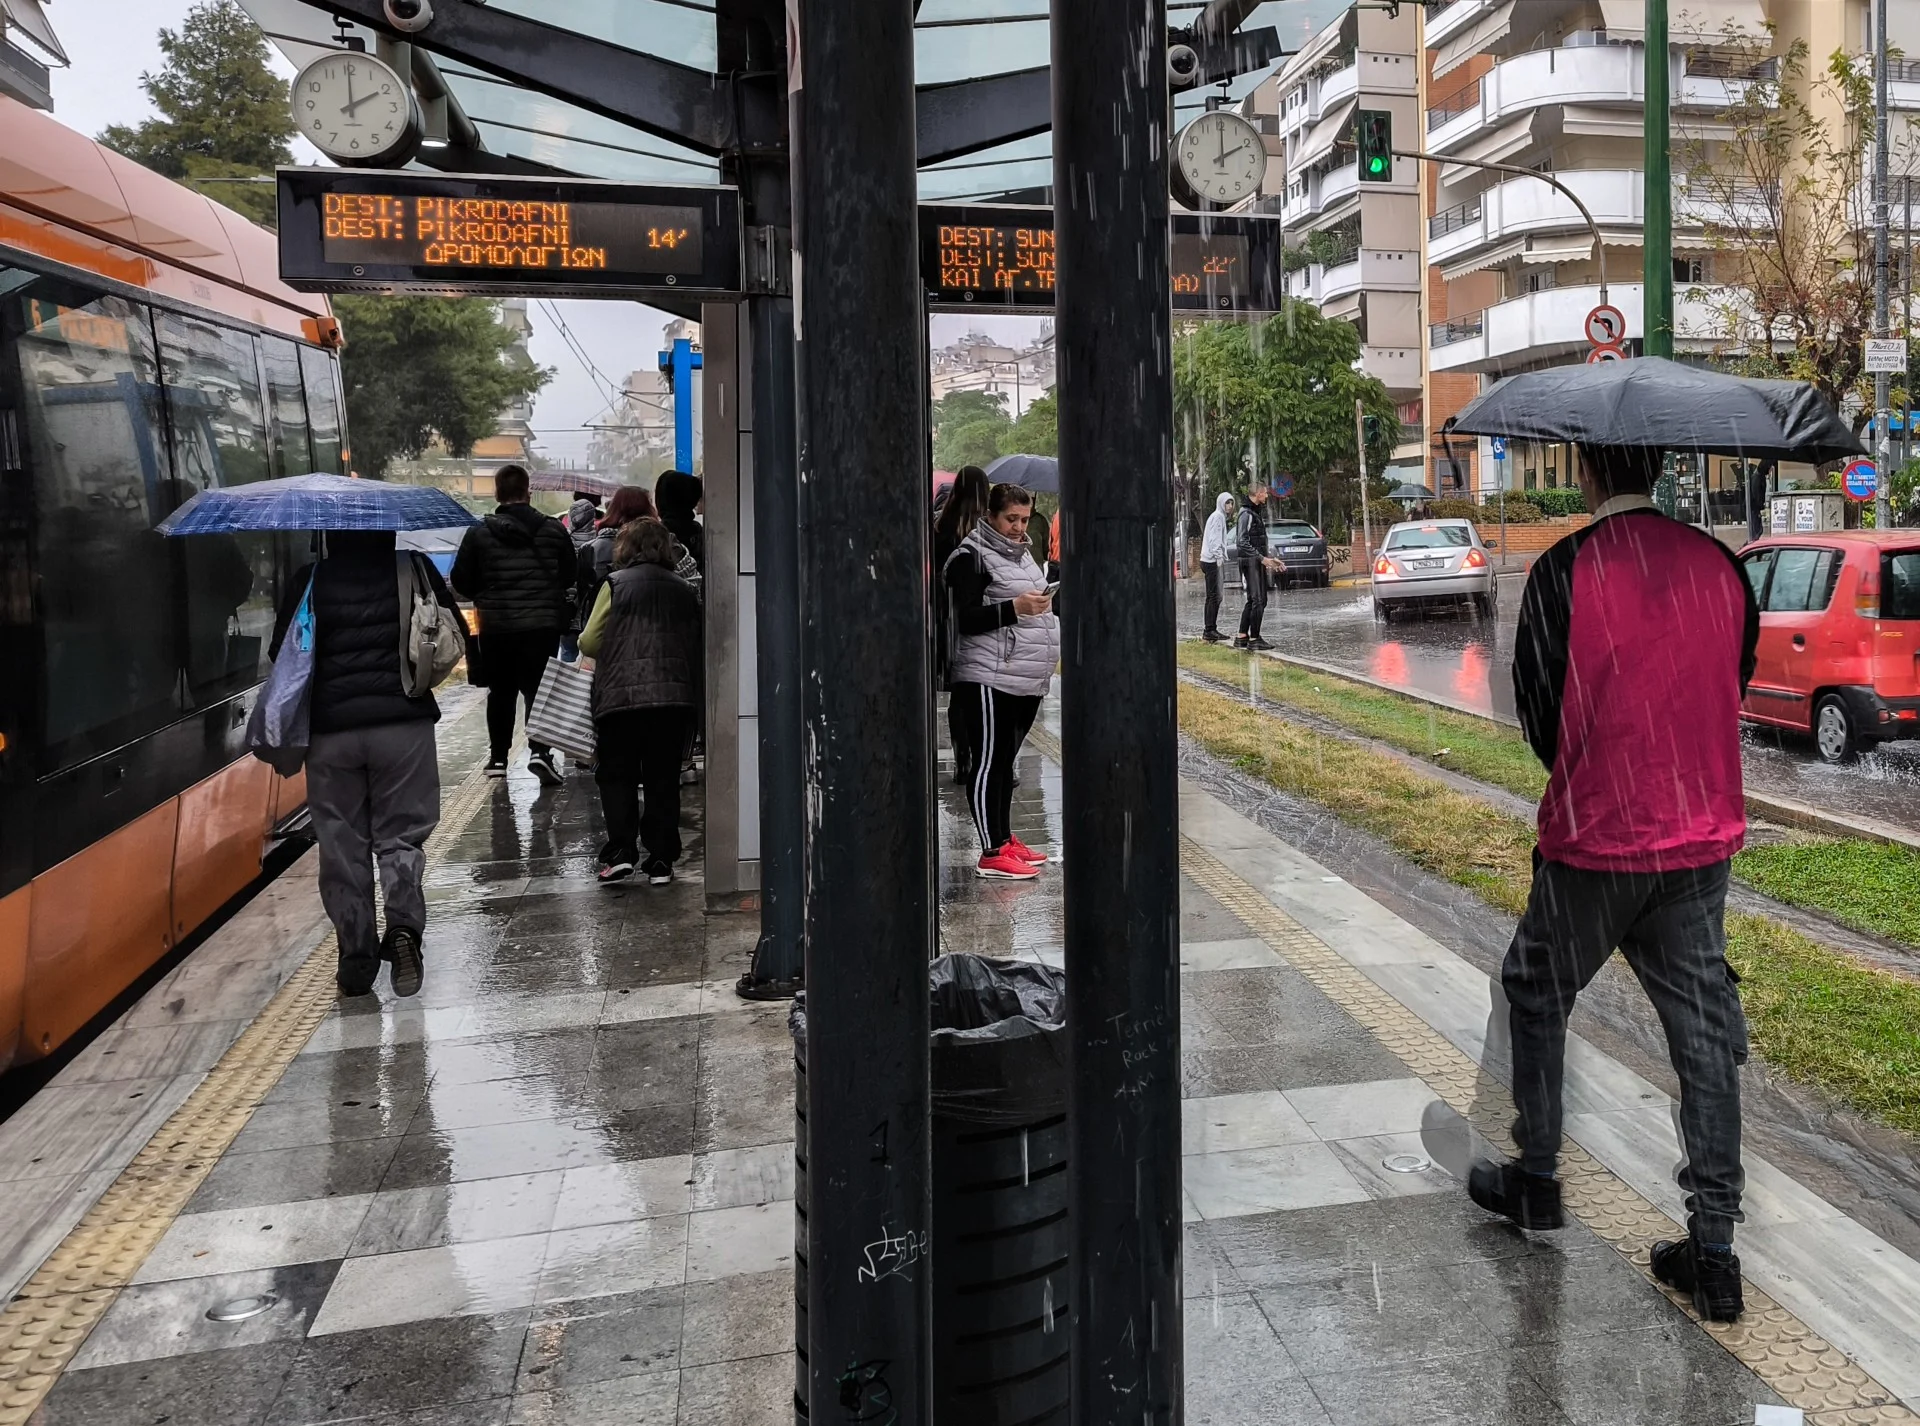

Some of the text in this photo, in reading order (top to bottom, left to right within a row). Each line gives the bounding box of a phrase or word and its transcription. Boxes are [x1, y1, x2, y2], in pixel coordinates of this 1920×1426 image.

[325, 69, 335, 79] 11
[309, 82, 321, 93] 10
[381, 84, 391, 95] 2
[306, 100, 315, 111] 9
[389, 102, 398, 113] 3
[313, 119, 322, 130] 8
[384, 120, 394, 132] 4
[1201, 124, 1209, 134] 11
[329, 132, 338, 144] 7
[350, 138, 359, 149] 6
[371, 134, 380, 145] 5
[1189, 136, 1199, 145] 10
[1243, 138, 1251, 148] 2
[1187, 152, 1194, 162] 9
[1249, 154, 1256, 164] 3
[1192, 168, 1199, 178] 8
[1244, 171, 1252, 180] 4
[1203, 180, 1211, 190] 7
[1218, 185, 1226, 195] 6
[1234, 182, 1241, 191] 5
[325, 193, 569, 224] DEST: PIKRODAFNI
[325, 217, 405, 240] DEST:
[417, 220, 570, 246] PIKRODAFNI
[940, 226, 1003, 247] DEST:
[425, 244, 606, 268] ΔΡΟΜΟΛΟΓΙΩΝ
[941, 249, 1003, 267] DEST:
[1122, 1041, 1158, 1068] Rock
